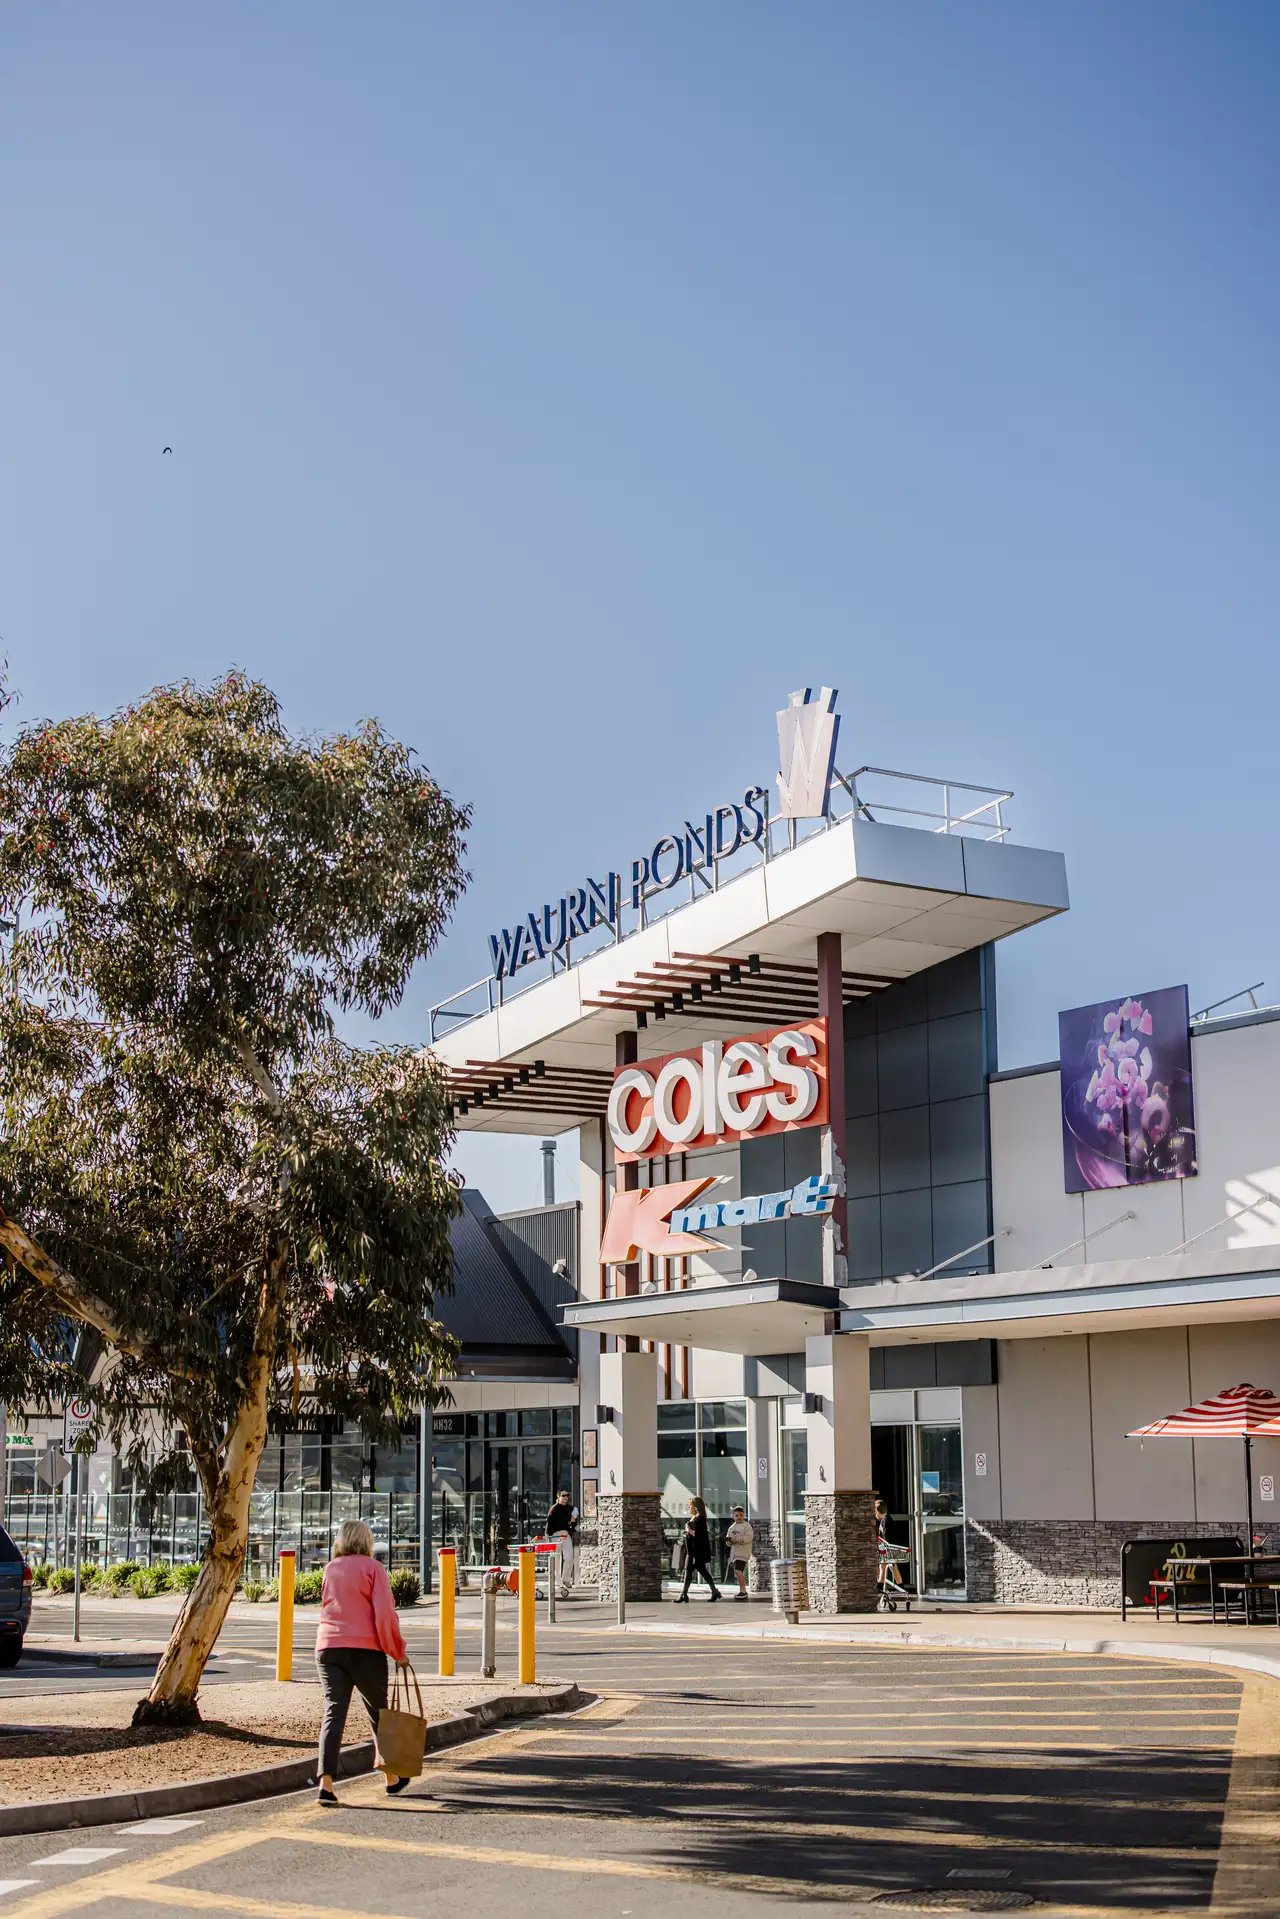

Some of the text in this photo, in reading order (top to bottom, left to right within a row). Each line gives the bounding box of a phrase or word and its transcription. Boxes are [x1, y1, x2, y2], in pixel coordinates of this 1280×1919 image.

[487, 786, 764, 980] WAURN PONDS
[607, 1030, 819, 1153] coles
[599, 1174, 838, 1264] Kmart
